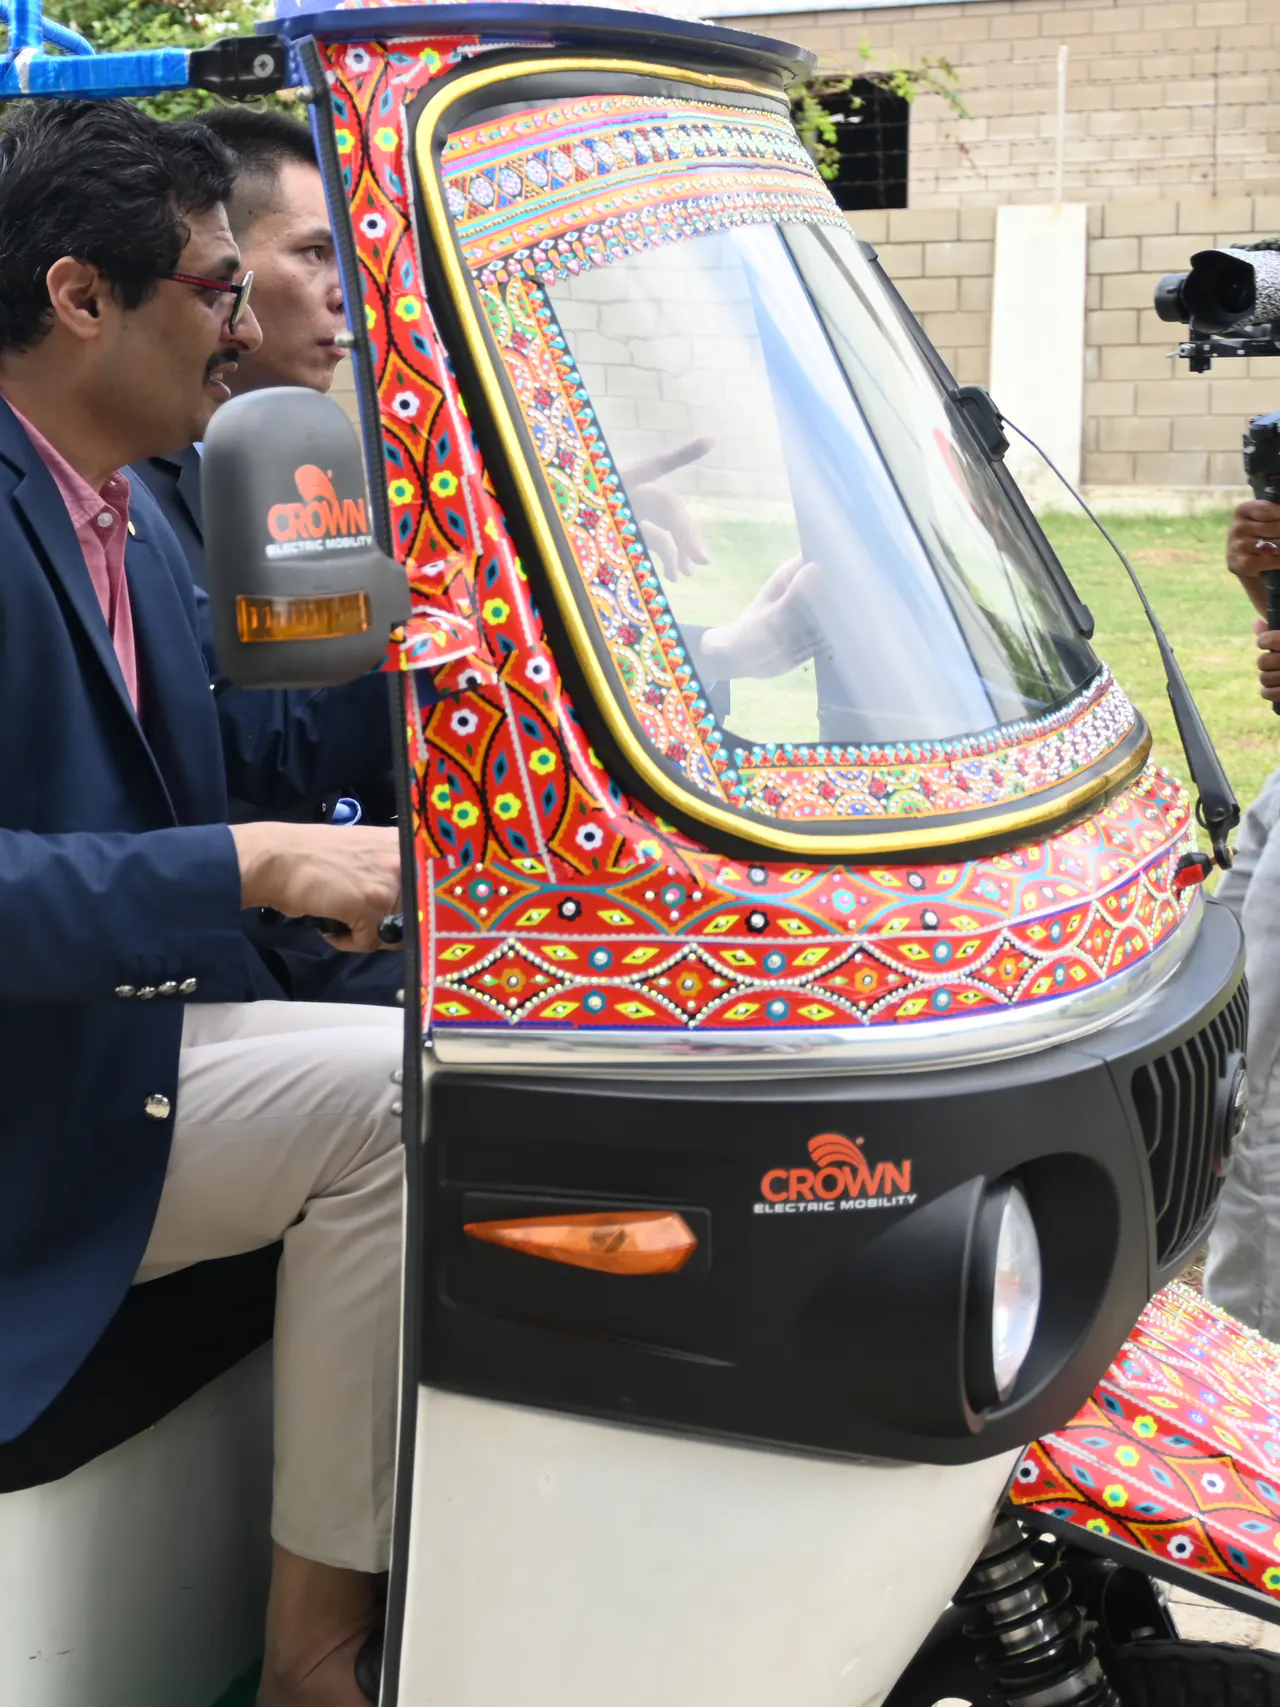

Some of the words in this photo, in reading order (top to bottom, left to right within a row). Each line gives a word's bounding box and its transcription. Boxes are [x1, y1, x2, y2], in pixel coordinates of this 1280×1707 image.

[267, 498, 367, 542] CROWN
[760, 1160, 912, 1202] CROWN
[753, 1201, 835, 1214] ELECTRIC
[840, 1194, 917, 1210] MOBILITY
